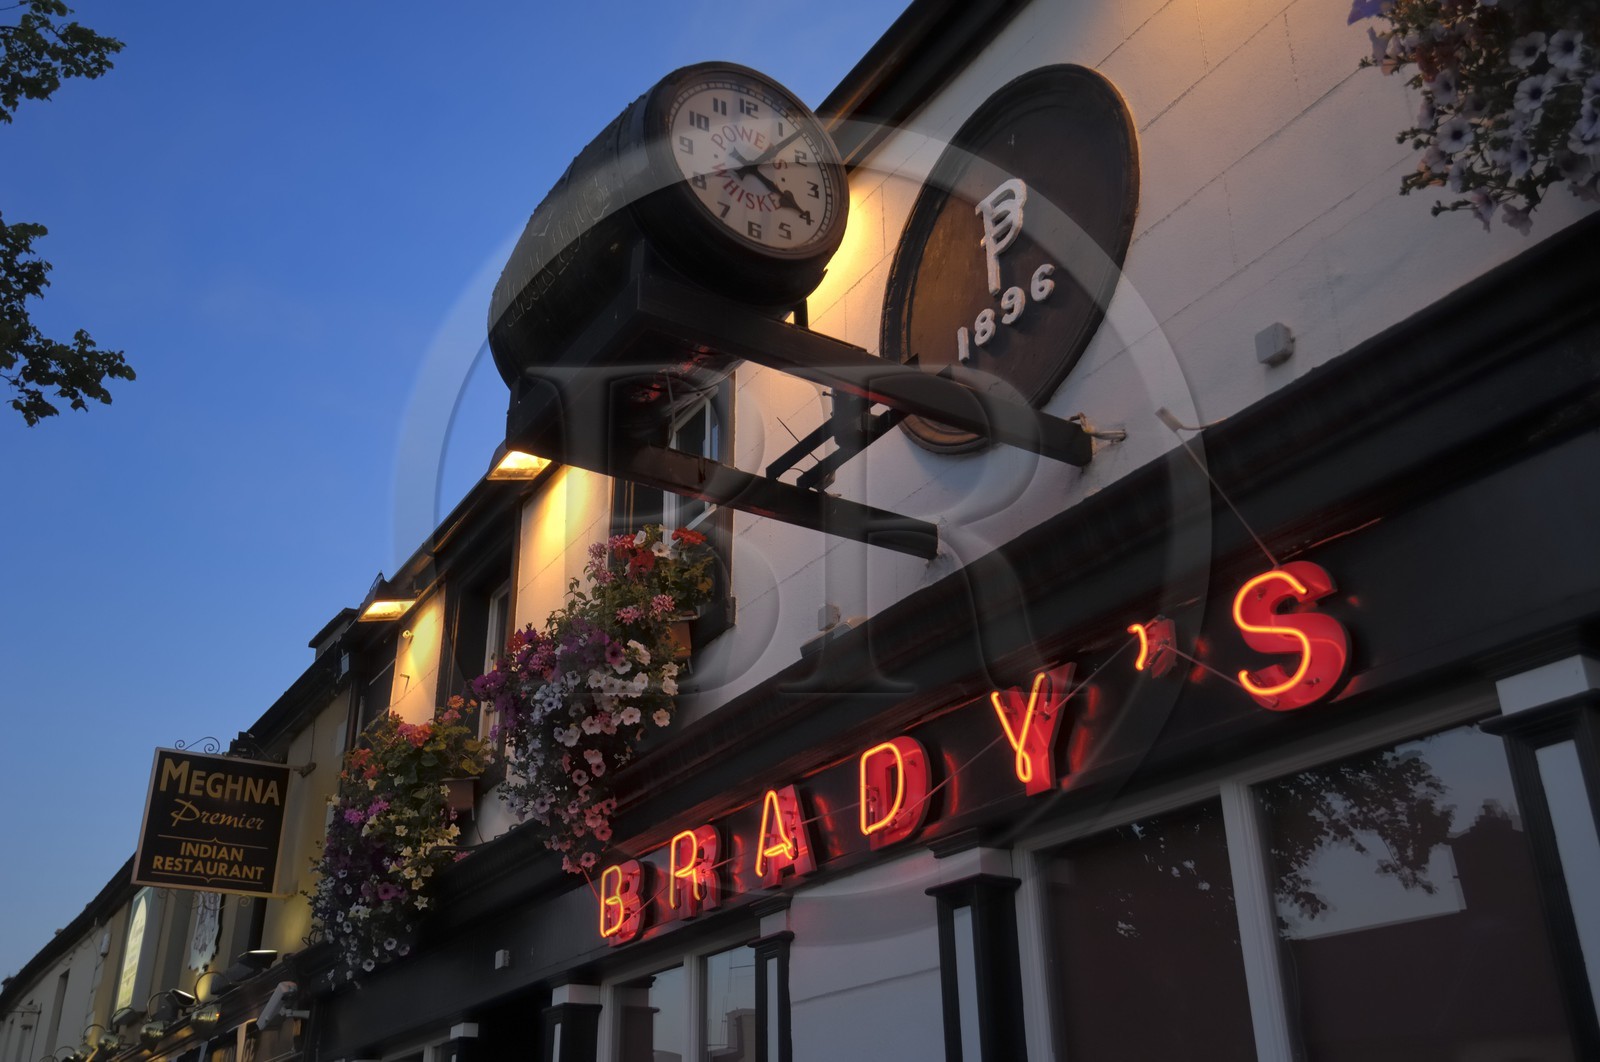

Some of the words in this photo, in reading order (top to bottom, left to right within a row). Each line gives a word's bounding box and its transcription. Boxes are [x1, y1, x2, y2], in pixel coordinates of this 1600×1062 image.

[713, 97, 727, 116] 11
[739, 98, 759, 119] 12
[689, 111, 709, 132] 10
[679, 136, 694, 155] 9
[795, 149, 807, 167] 2
[692, 171, 707, 191] 8
[712, 162, 783, 212] WHISKE
[807, 181, 819, 199] 3
[717, 201, 731, 219] 7
[799, 210, 815, 226] 4
[748, 221, 762, 240] 6
[778, 222, 792, 240] 5
[957, 263, 1055, 362] 1896
[598, 560, 1350, 947] BRADY'S
[159, 758, 280, 806] MEGHNA
[170, 798, 264, 830] Premier
[180, 841, 244, 862] INDIAN
[152, 855, 264, 880] RESTAURANT
